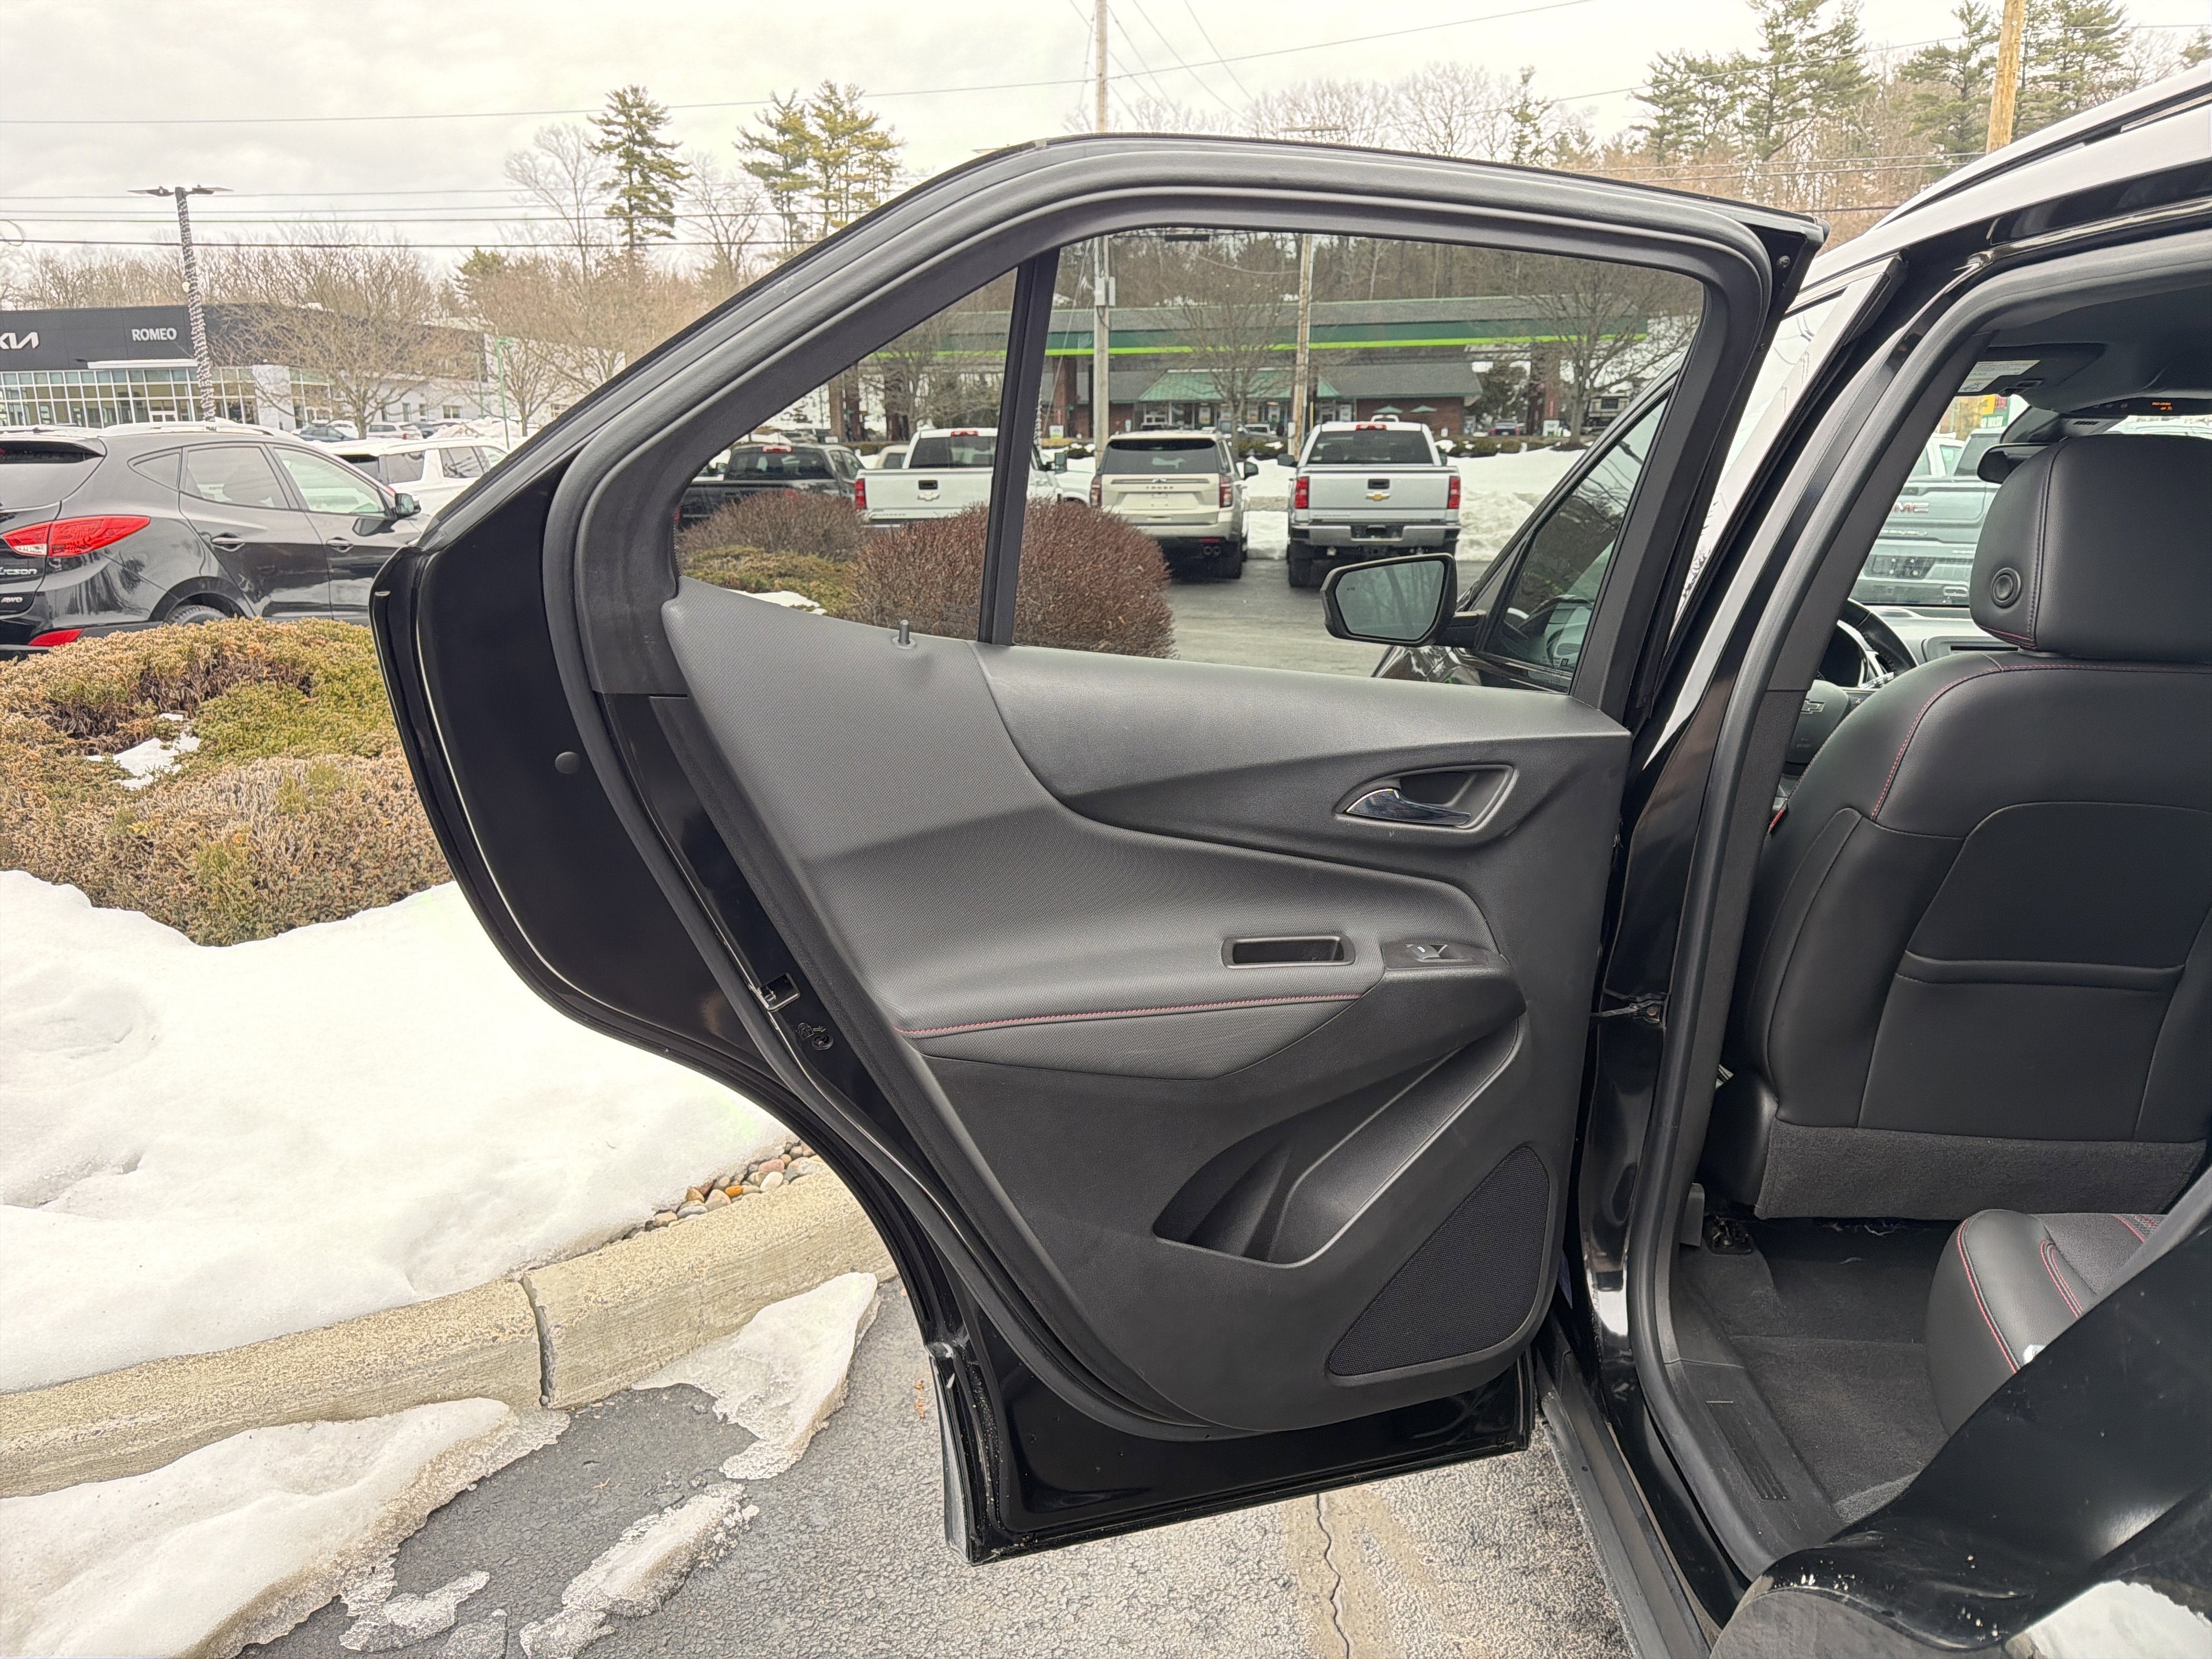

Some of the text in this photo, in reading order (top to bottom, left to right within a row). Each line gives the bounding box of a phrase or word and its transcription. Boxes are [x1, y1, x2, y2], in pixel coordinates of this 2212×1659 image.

[132, 328, 177, 341] ROMEO
[1893, 502, 1929, 512] MC
[0, 566, 37, 575] ucson
